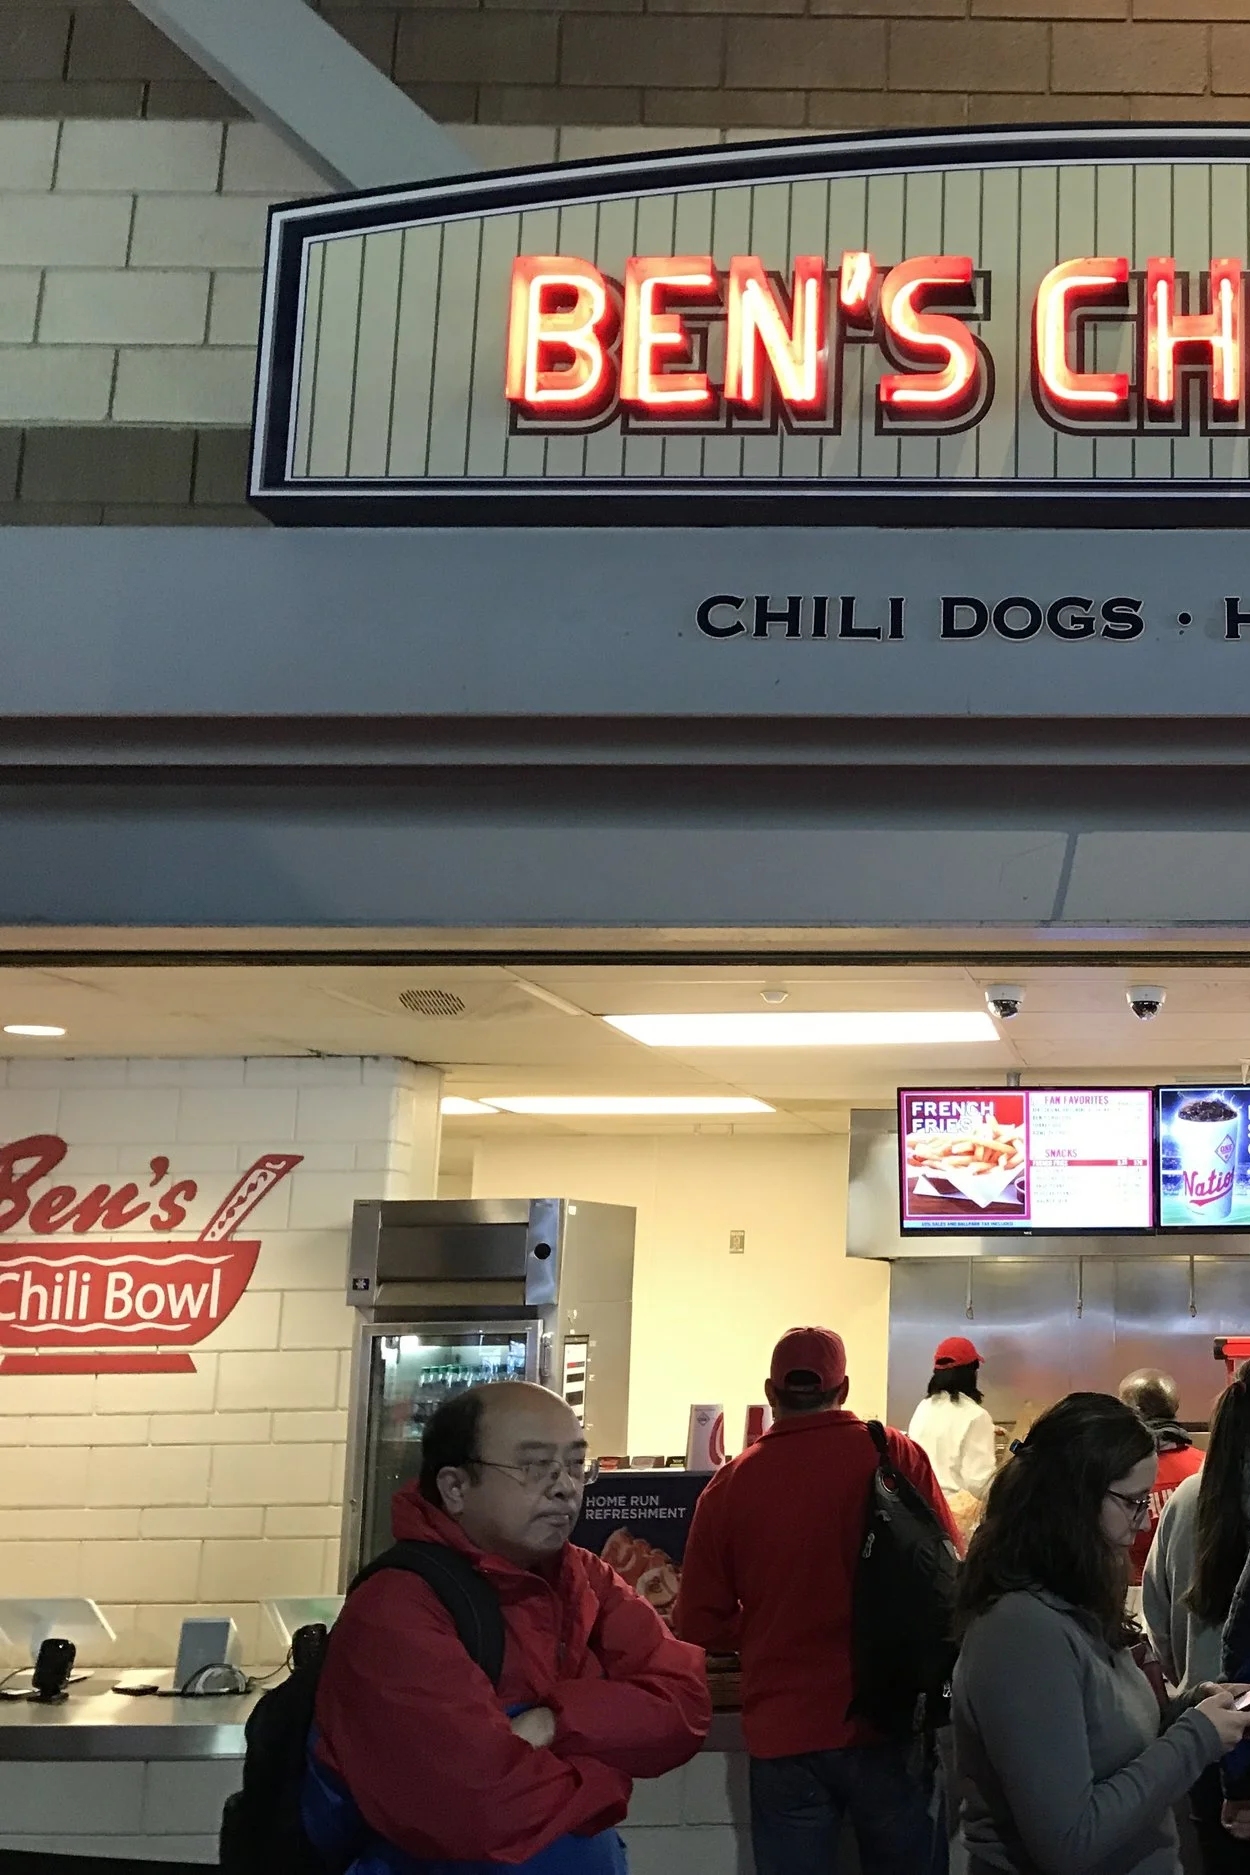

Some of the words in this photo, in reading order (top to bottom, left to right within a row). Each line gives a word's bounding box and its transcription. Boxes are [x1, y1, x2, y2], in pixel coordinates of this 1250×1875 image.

[504, 250, 979, 412] BEN'S
[696, 594, 906, 641] CHILI
[939, 595, 1145, 642] DOGS
[1044, 1095, 1061, 1105] FAN
[1063, 1095, 1109, 1105] FAVORITES
[911, 1100, 994, 1117] FRENCH
[911, 1118, 973, 1134] FRIES
[1045, 1149, 1078, 1158] SNACKS
[0, 1134, 198, 1234] Ben's
[0, 1269, 91, 1322] Chili
[104, 1268, 221, 1321] Bowl
[585, 1495, 627, 1508] HOME
[630, 1494, 660, 1507] RUN
[584, 1506, 687, 1521] REFRESHMENT
